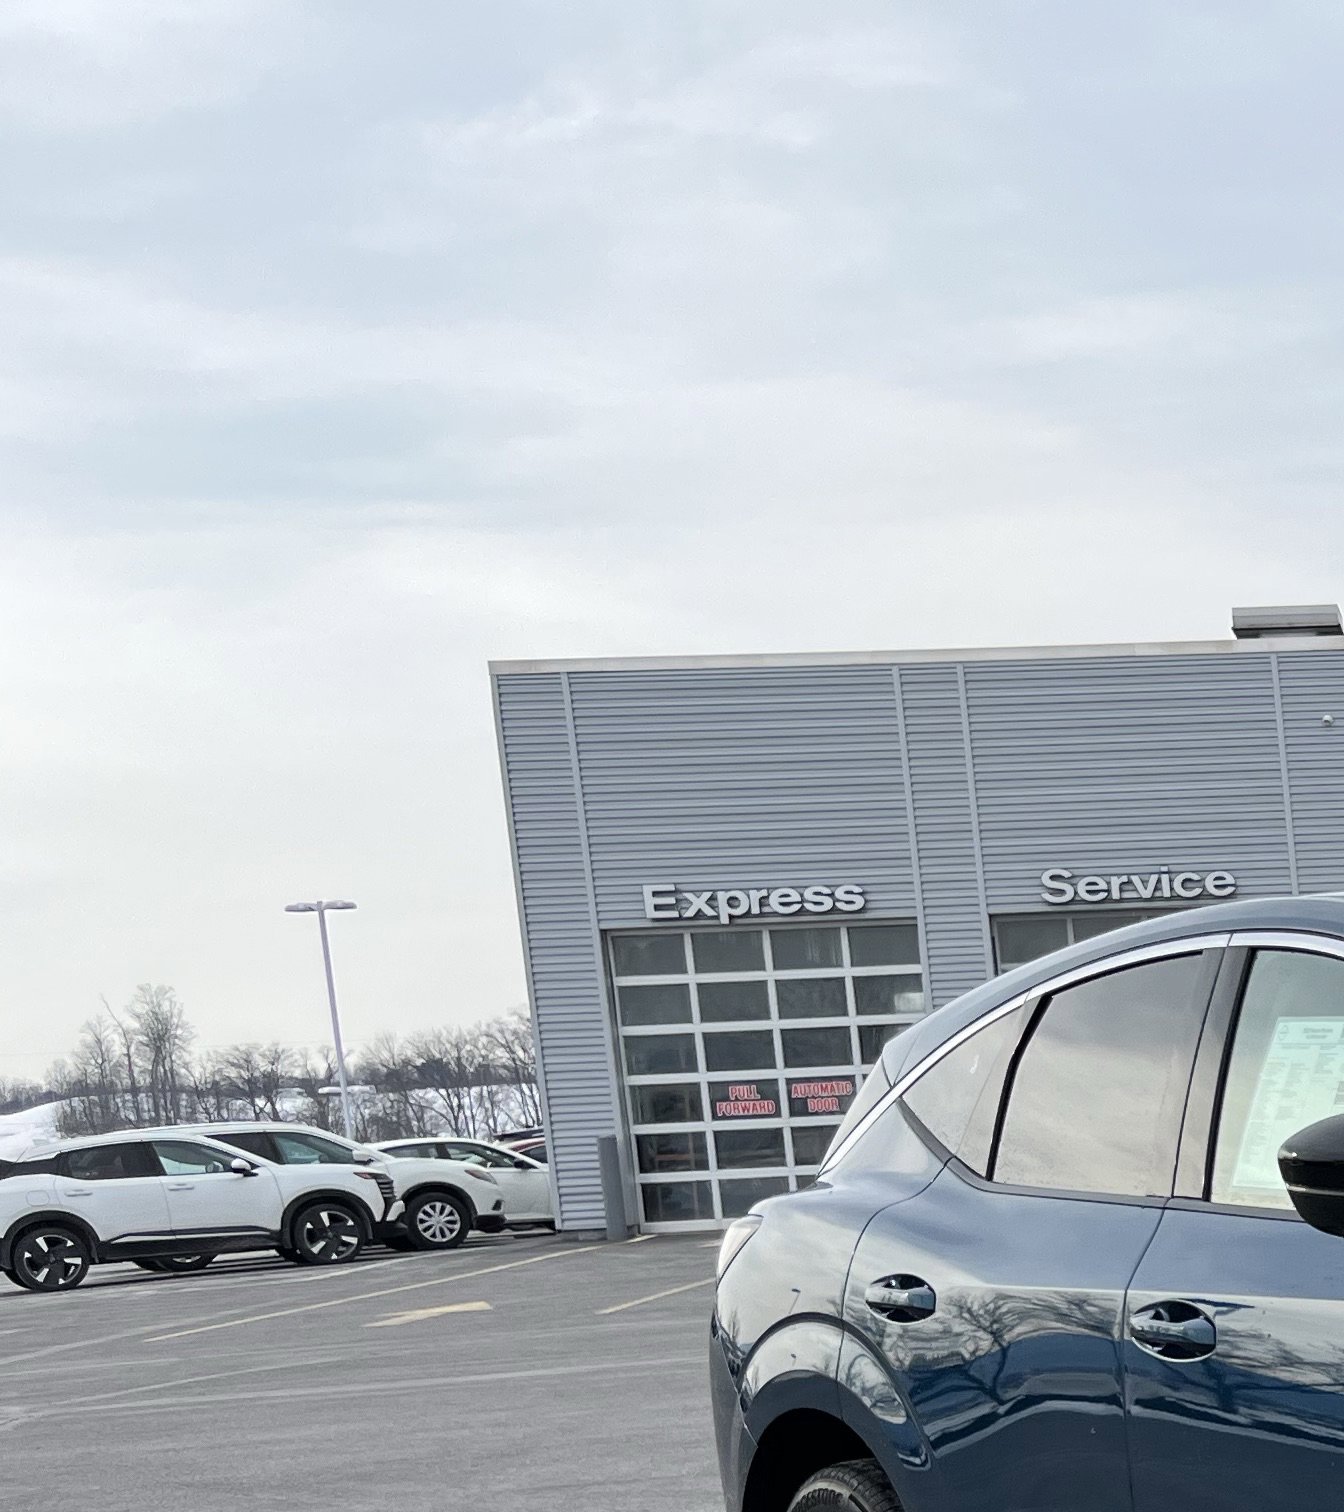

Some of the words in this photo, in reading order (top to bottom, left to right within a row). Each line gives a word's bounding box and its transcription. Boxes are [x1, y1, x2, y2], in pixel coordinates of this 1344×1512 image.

[1040, 865, 1237, 904] Service
[642, 883, 866, 925] Express
[728, 1085, 761, 1100] PULL
[791, 1081, 853, 1098] AUTOMATIC
[716, 1100, 776, 1117] FORWARD
[807, 1098, 840, 1113] DOOR
